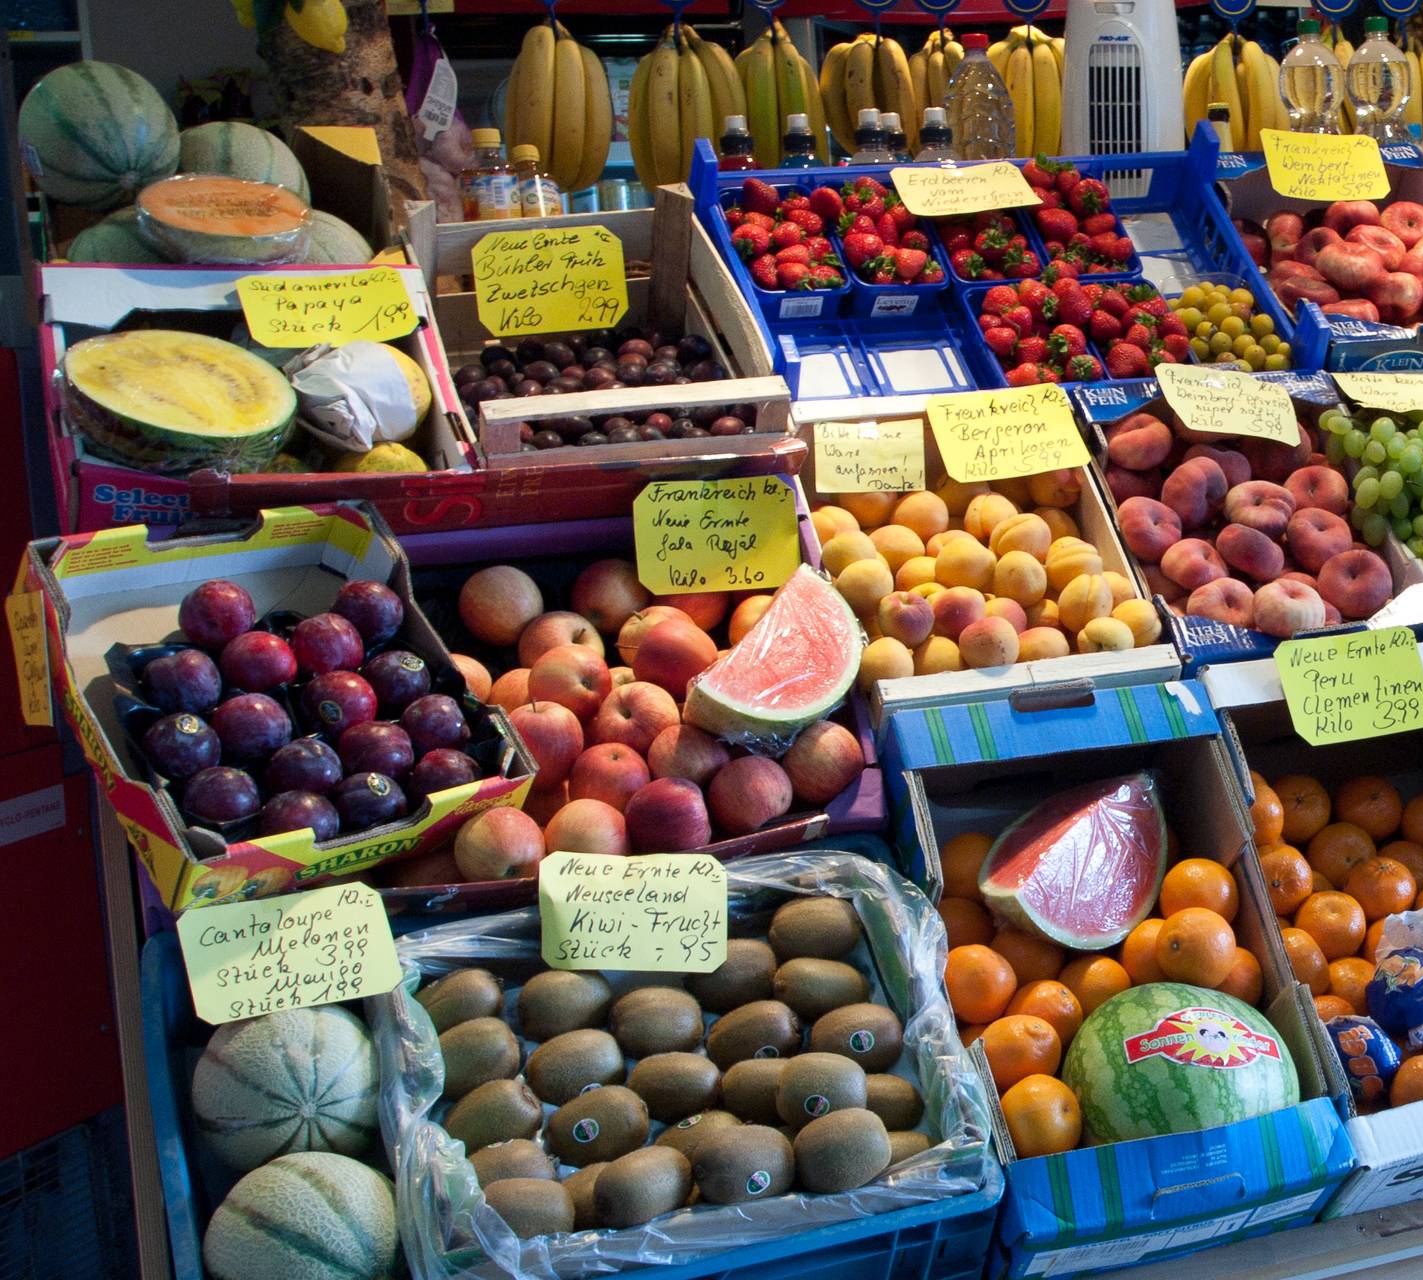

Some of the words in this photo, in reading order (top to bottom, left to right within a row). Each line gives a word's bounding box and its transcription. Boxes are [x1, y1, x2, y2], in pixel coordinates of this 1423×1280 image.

[263, 294, 362, 315] Papaya
[1088, 396, 1129, 407] FEIN
[951, 423, 1047, 446] Bergeron
[965, 462, 999, 481] Kilo
[94, 484, 190, 509] Select
[648, 482, 756, 502] Frankreich
[112, 504, 195, 524] Frui
[669, 565, 706, 588] Kilo
[725, 566, 764, 585] 3.60
[1290, 647, 1338, 668] Neue
[1347, 635, 1386, 660] Ernte
[1303, 669, 1354, 693] Peru
[1316, 711, 1353, 737] Kilo
[296, 835, 423, 882] SHARON
[559, 857, 613, 876] Neue
[622, 861, 681, 880] Ernte
[566, 881, 690, 904] Neuseeland
[200, 908, 334, 948] Cantaloupe
[251, 923, 370, 961] Melonen
[556, 935, 632, 961] Stück
[217, 956, 293, 988] Stück
[229, 987, 303, 1019] Stück
